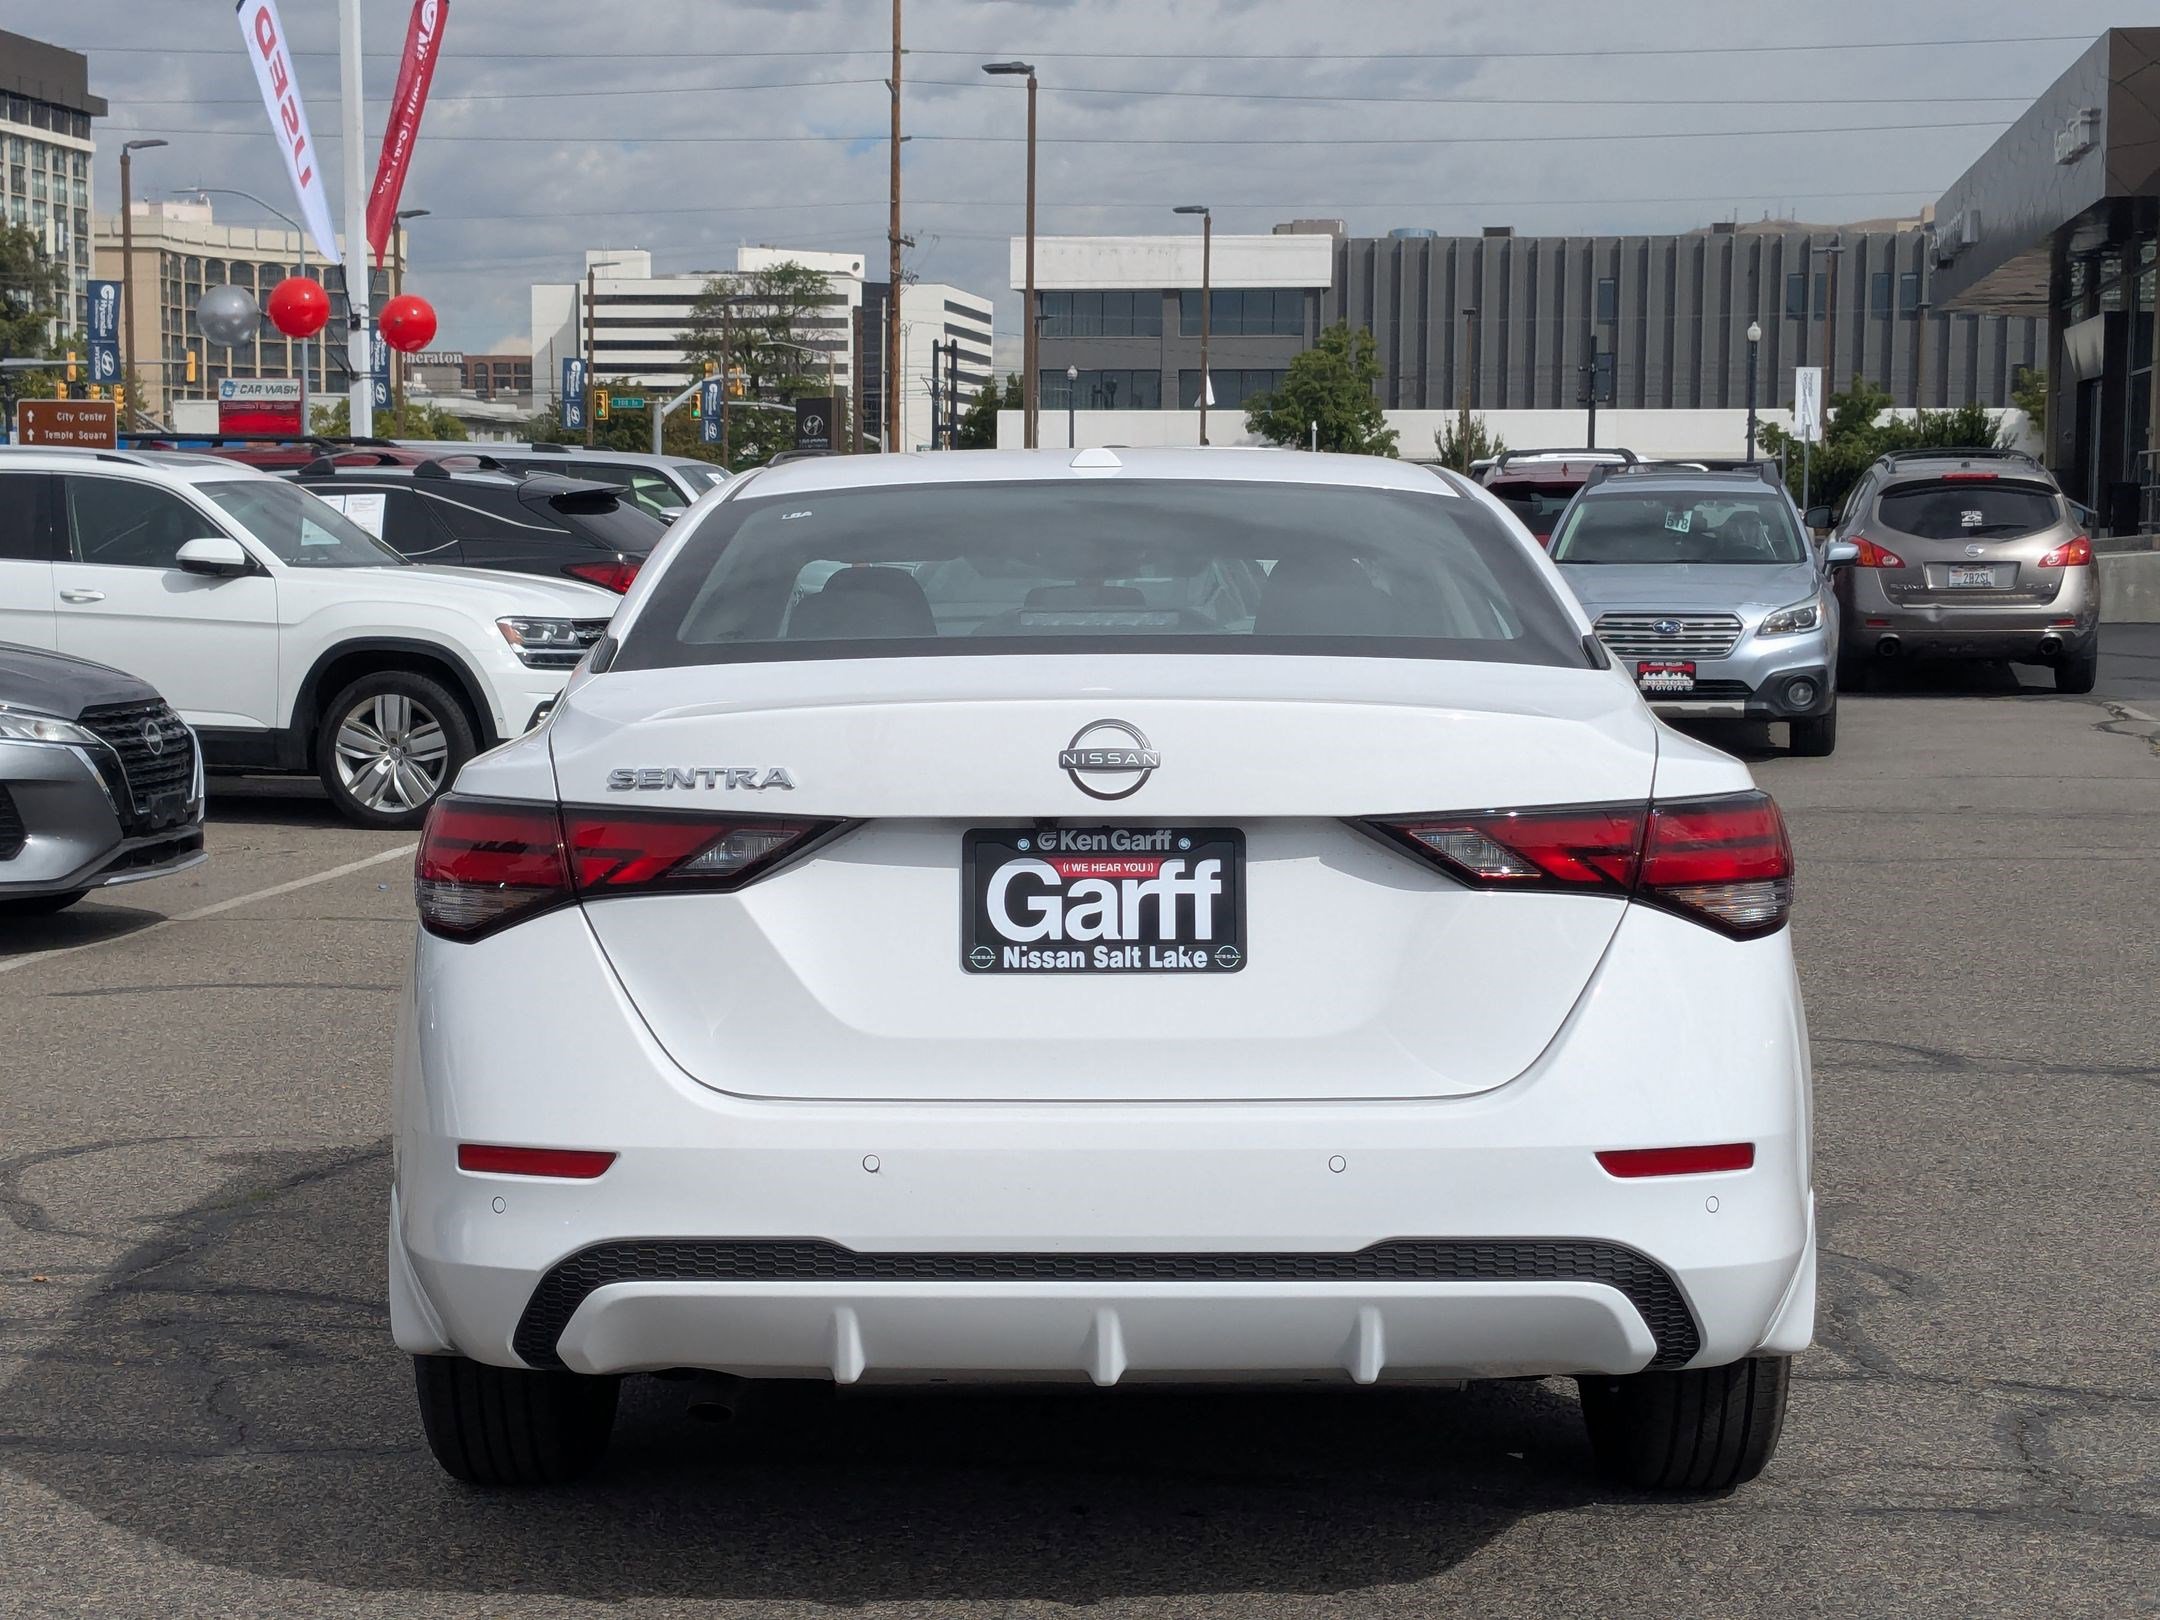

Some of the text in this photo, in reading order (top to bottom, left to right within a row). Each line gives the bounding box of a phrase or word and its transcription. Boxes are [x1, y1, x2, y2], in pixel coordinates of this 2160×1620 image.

[240, 384, 299, 394] CAR WASH
[56, 411, 107, 423] City Center
[44, 430, 108, 441] Temple Square
[1062, 752, 1157, 765] NISSAN
[607, 767, 796, 791] SENTRA
[1060, 829, 1173, 851] Ken Garff
[1071, 863, 1146, 873] WE HEAR YOU
[986, 857, 1222, 943] Garff
[1003, 945, 1208, 968] Nissan Salt Lake
